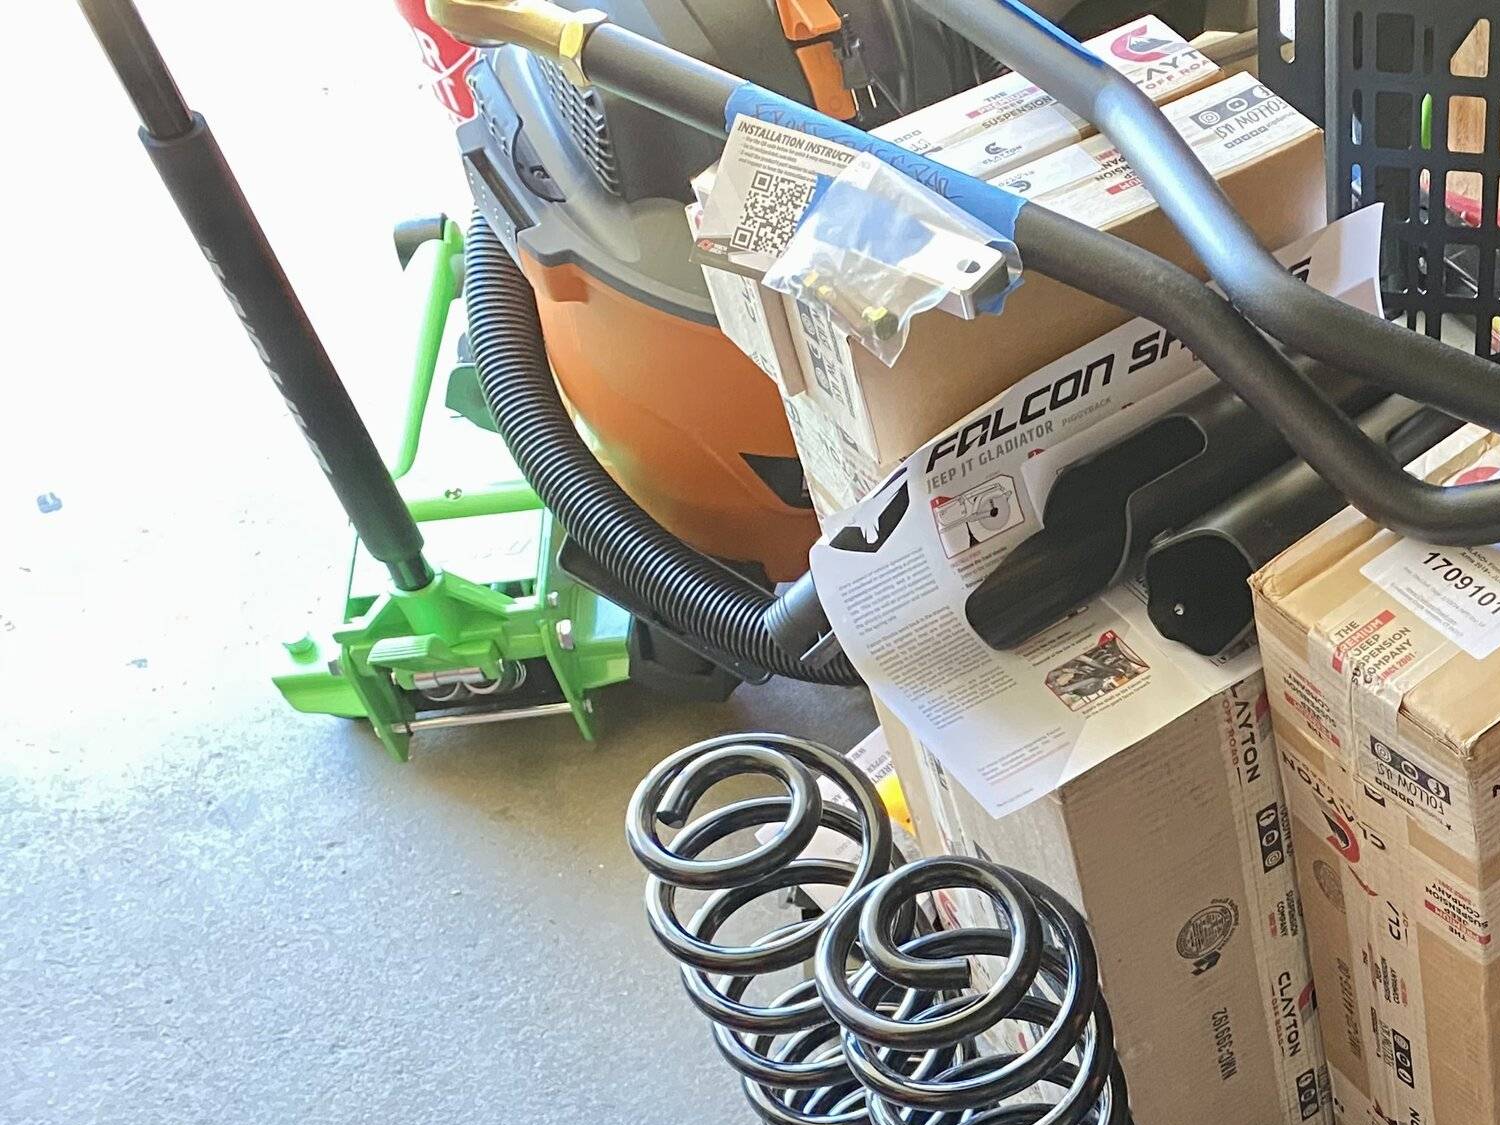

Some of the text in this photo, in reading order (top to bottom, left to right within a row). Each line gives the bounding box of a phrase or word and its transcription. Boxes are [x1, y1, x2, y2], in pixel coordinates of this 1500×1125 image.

[982, 95, 1052, 129] SUSPENSION
[737, 121, 806, 153] INSTALLATION
[926, 354, 1115, 474] FALCON
[1061, 397, 1112, 427] PIGGYBACK
[927, 419, 1053, 493] JEEP JT GLADIATOR
[1334, 620, 1360, 639] THE
[1363, 638, 1413, 686] COMPANY
[1230, 680, 1261, 783] LAYTON
[1396, 775, 1445, 815] FOLLOW
[1275, 899, 1289, 938] COMPANY
[1425, 886, 1489, 930] SUSPENSION
[1432, 883, 1480, 919] COMPANY
[1278, 971, 1302, 1058] CLAYTON
